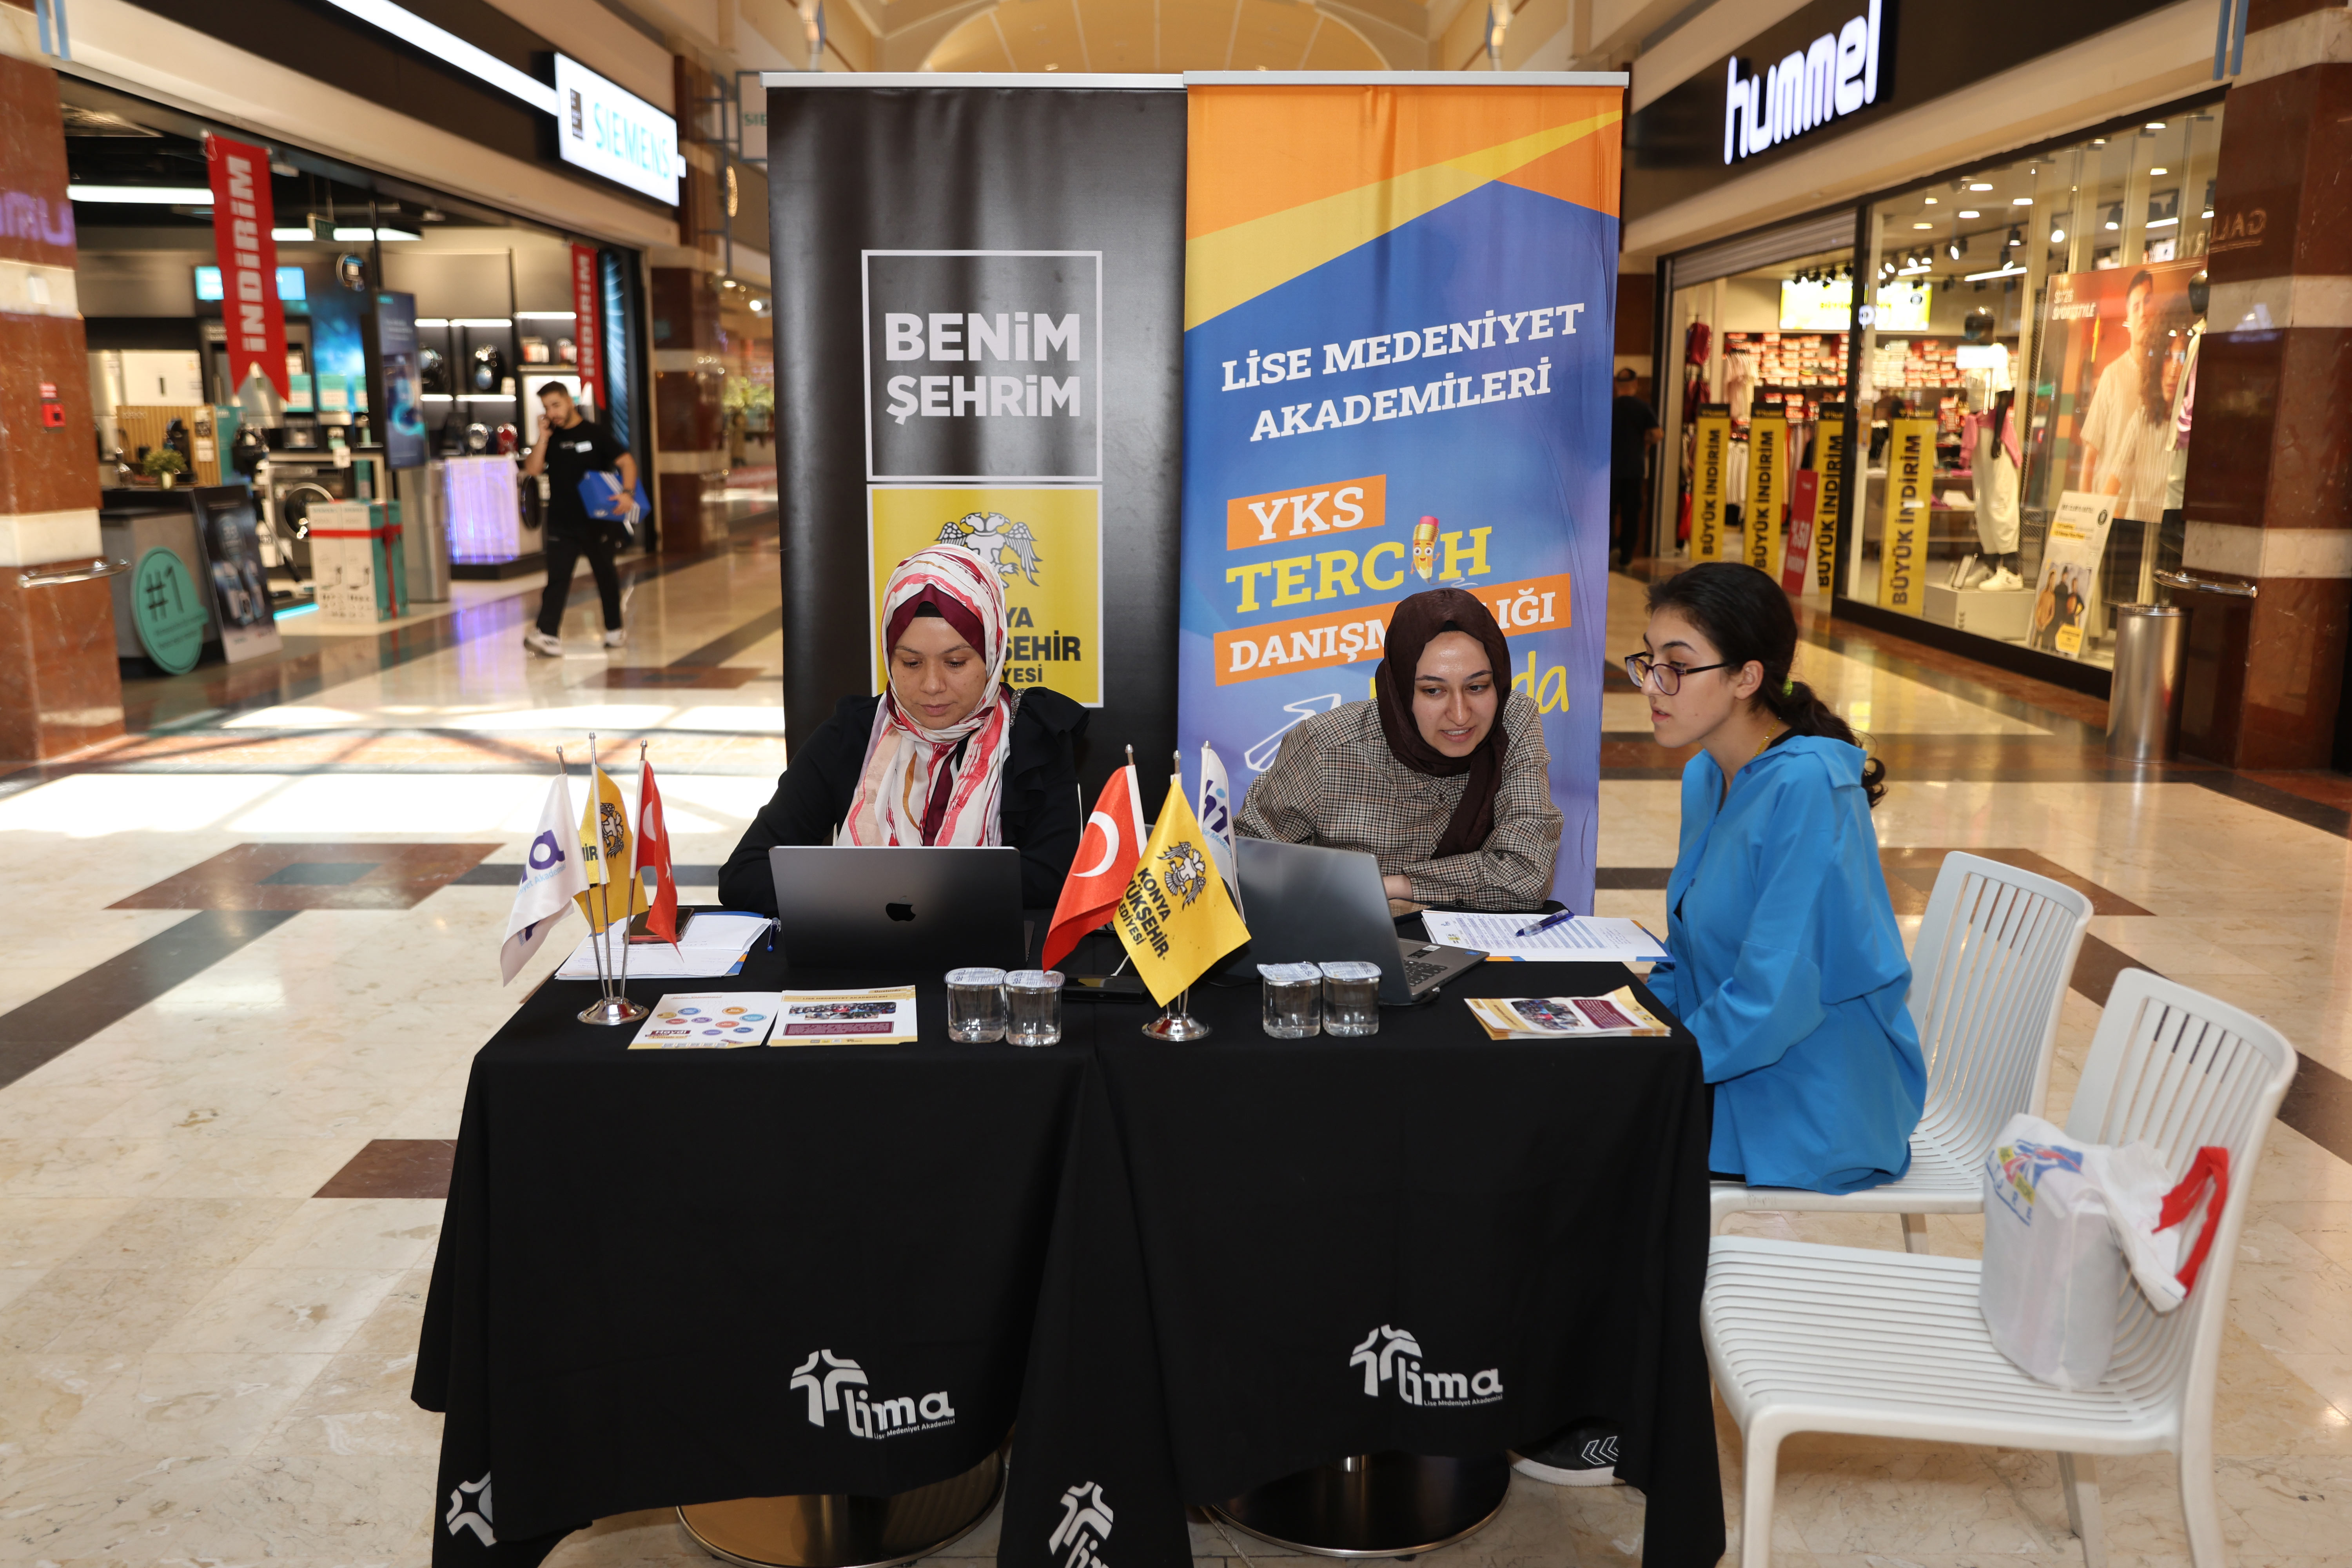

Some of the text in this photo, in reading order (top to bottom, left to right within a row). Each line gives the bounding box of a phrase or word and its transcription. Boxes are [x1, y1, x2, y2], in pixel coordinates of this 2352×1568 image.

[1724, 0, 1882, 165] hummel
[594, 101, 671, 179] SIEMENS
[1221, 303, 1585, 392] LİSE MEDENİYET
[1250, 356, 1552, 442] AKADEMİLERİ
[1248, 486, 1365, 541] YKS
[1699, 429, 1721, 555] BÜYÜK İNDİRİM
[1751, 430, 1774, 568] BÜYÜK İNDİRİM
[1889, 528, 1914, 606] BÜYÜK
[1137, 867, 1171, 922] KONYA
[887, 1424, 920, 1437] Medeniyet
[921, 1418, 955, 1431] Akademisi
[1472, 1394, 1503, 1405] Akademisi
